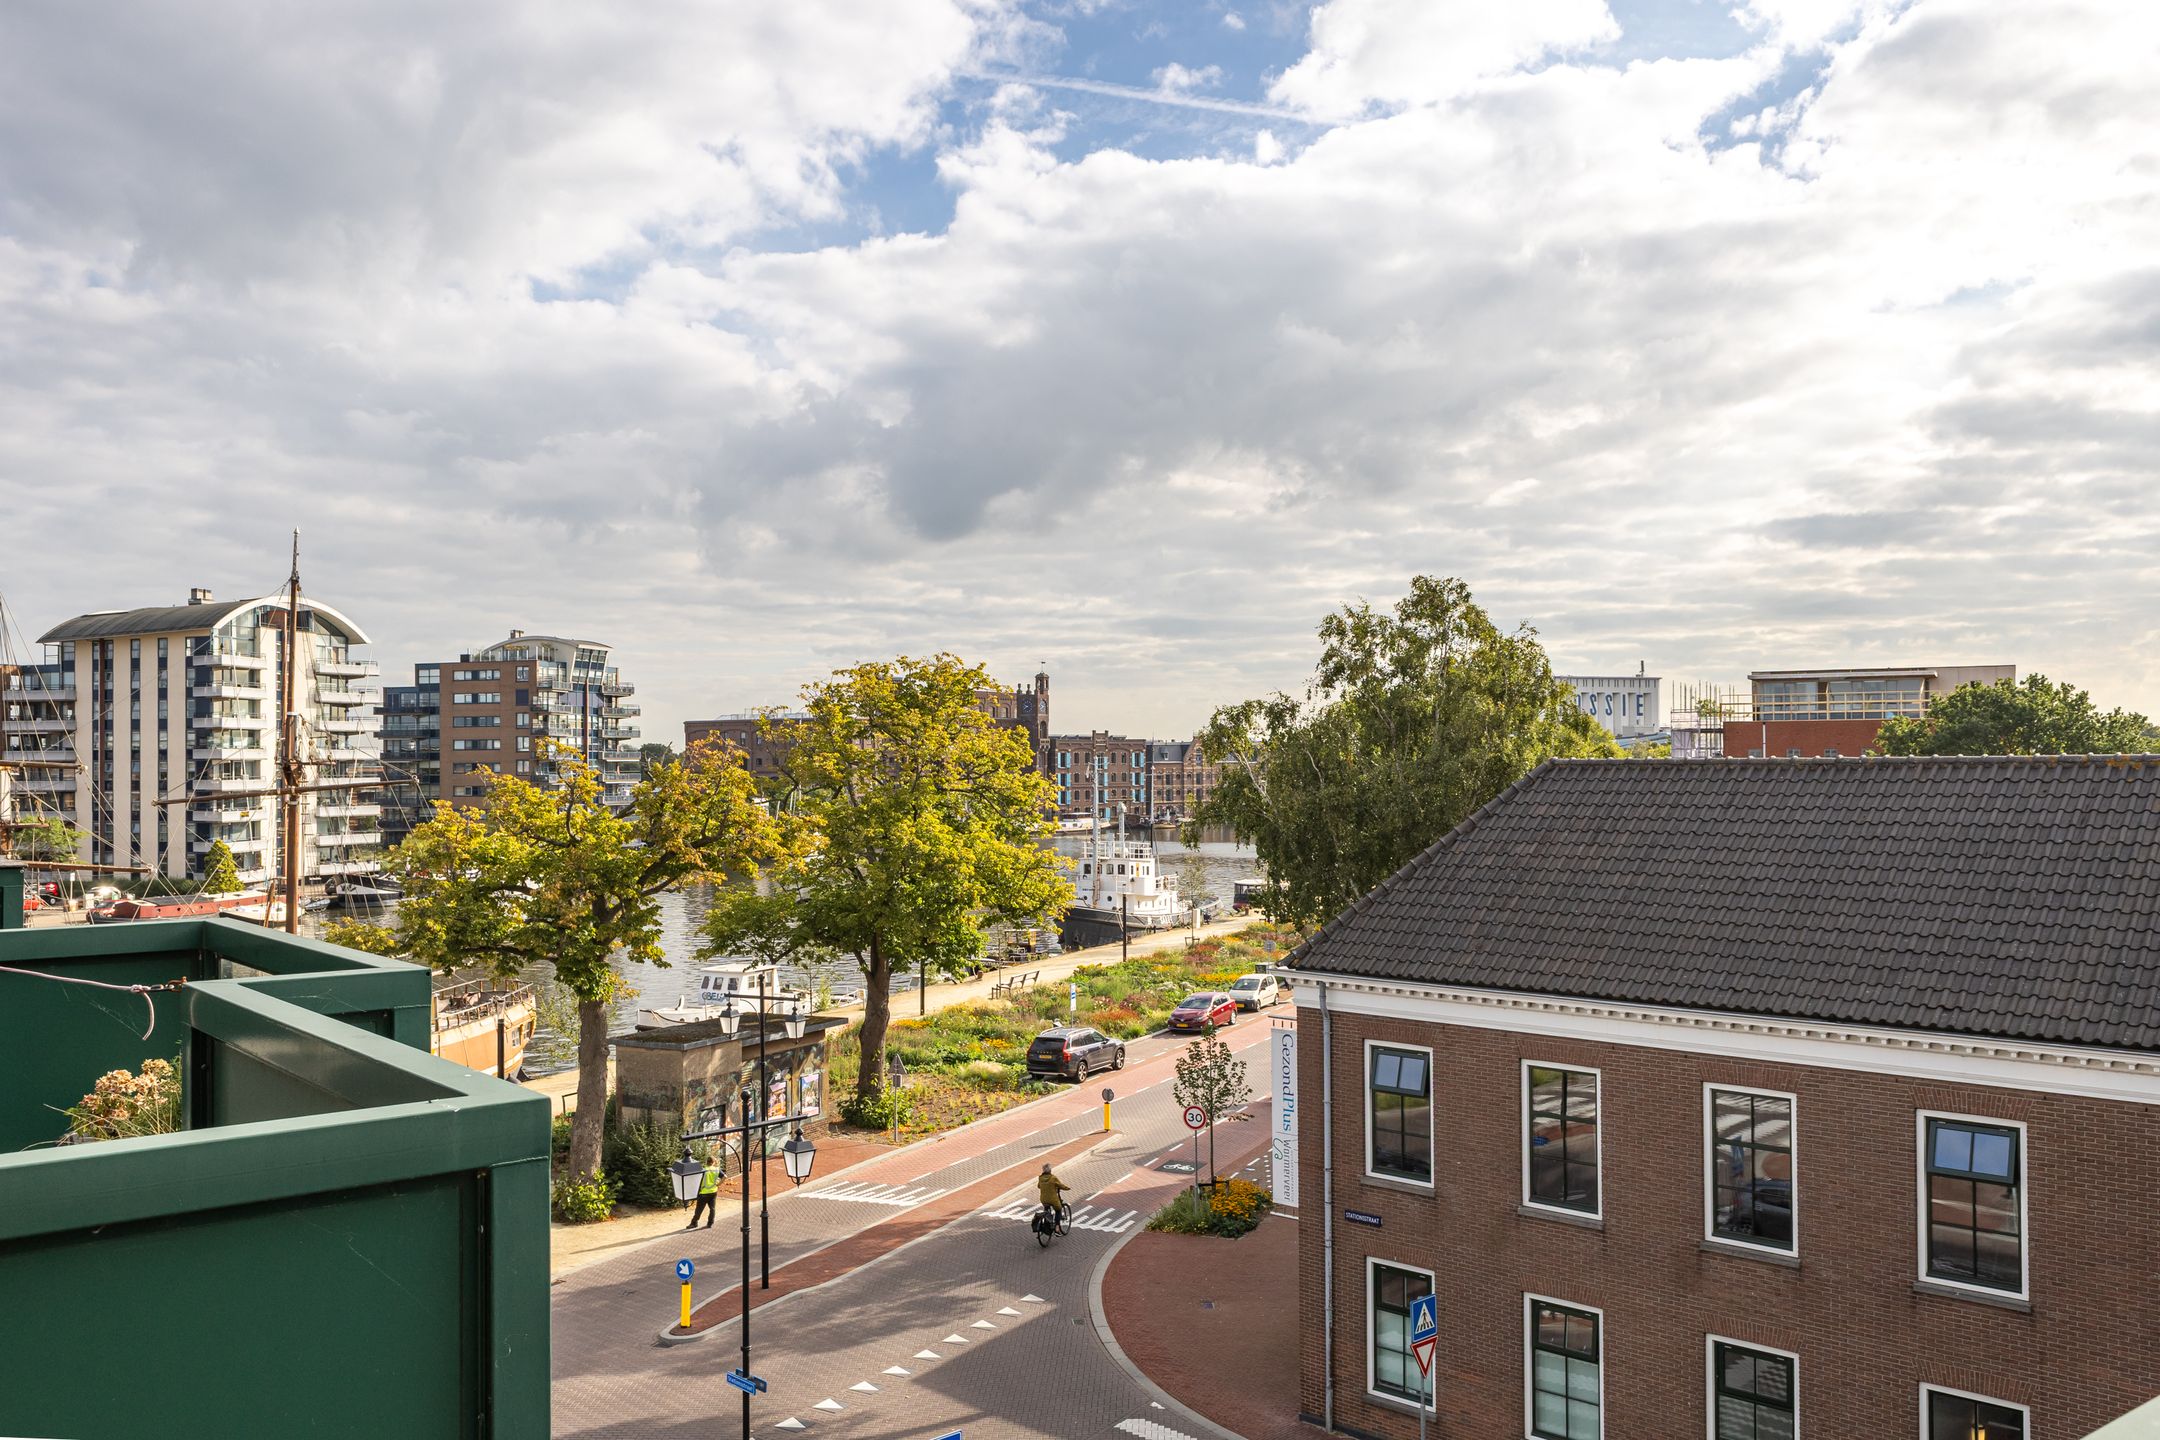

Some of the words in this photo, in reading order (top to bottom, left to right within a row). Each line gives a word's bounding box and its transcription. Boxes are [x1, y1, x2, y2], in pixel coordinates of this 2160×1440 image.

[1282, 1034, 1294, 1132] GezondPlus
[1188, 1112, 1203, 1123] 30
[1283, 1139, 1291, 1201] Wormerveer
[1345, 1212, 1380, 1224] STATIONSSTRAAT
